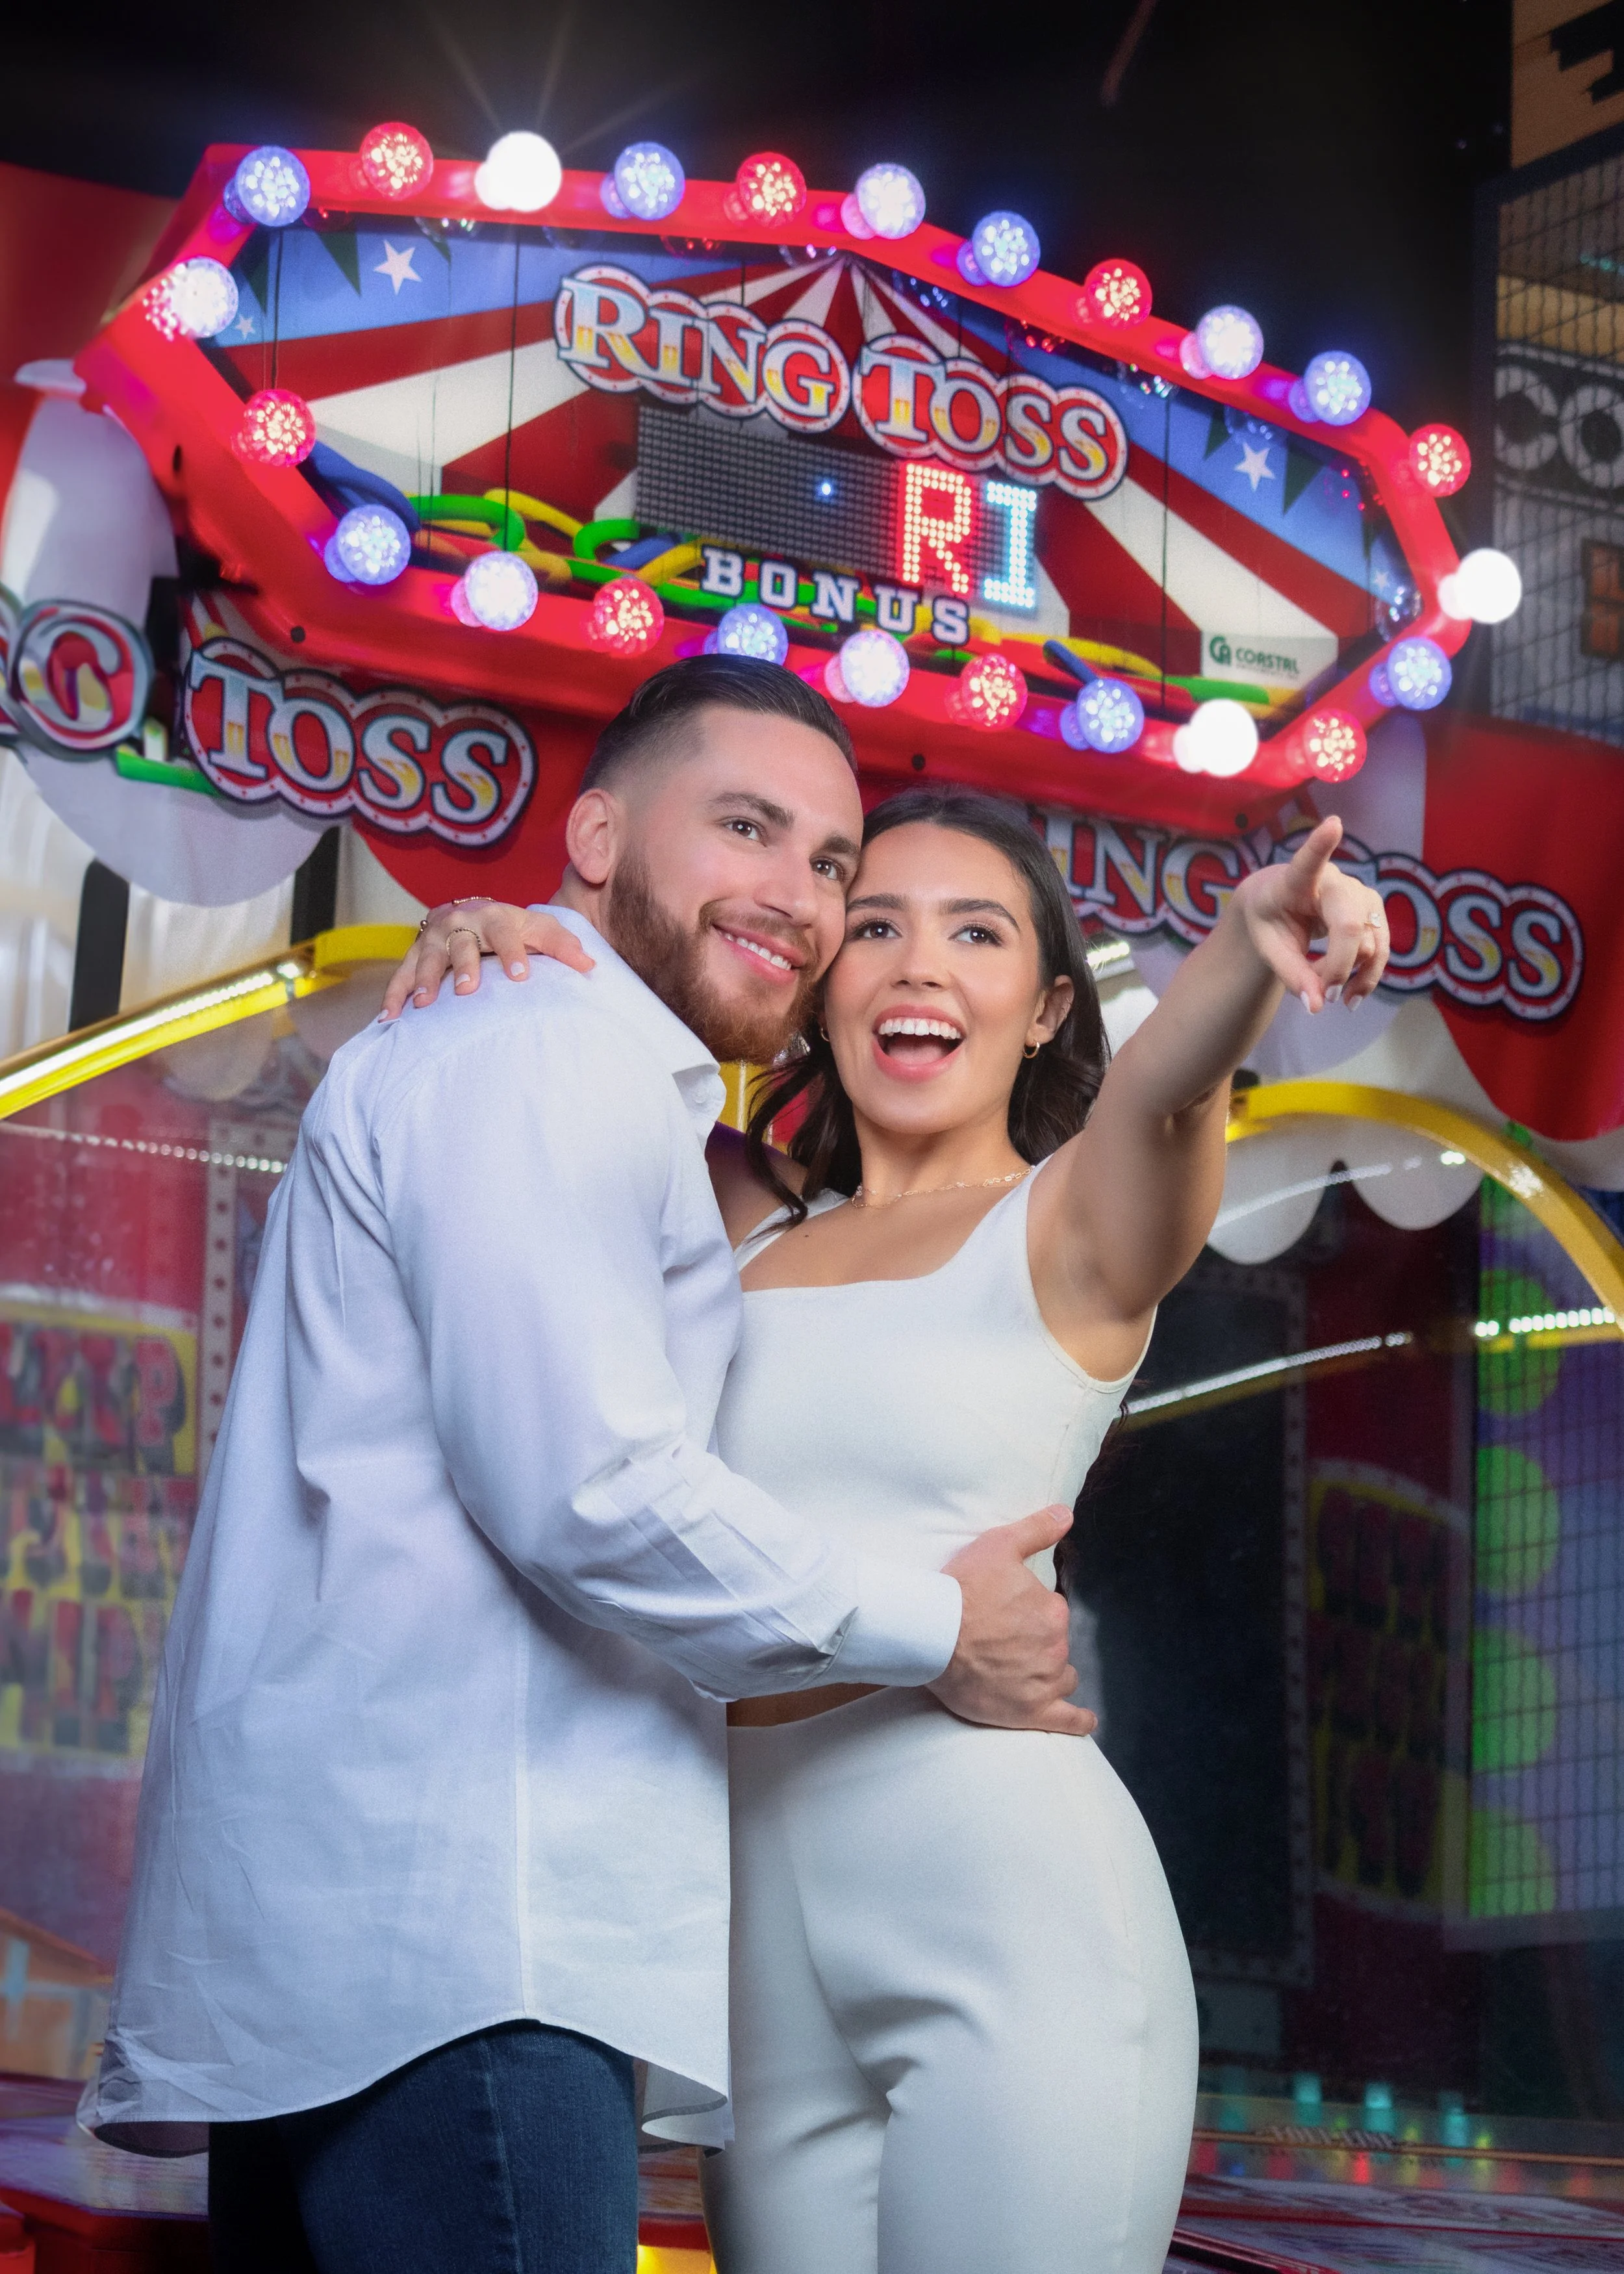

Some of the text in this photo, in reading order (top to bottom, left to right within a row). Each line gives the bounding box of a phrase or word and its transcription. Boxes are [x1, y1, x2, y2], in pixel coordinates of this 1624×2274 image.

[557, 278, 1111, 482] RING TOSS
[701, 546, 971, 645] BONUS
[904, 462, 1038, 609] RI
[189, 651, 509, 824] TOSS
